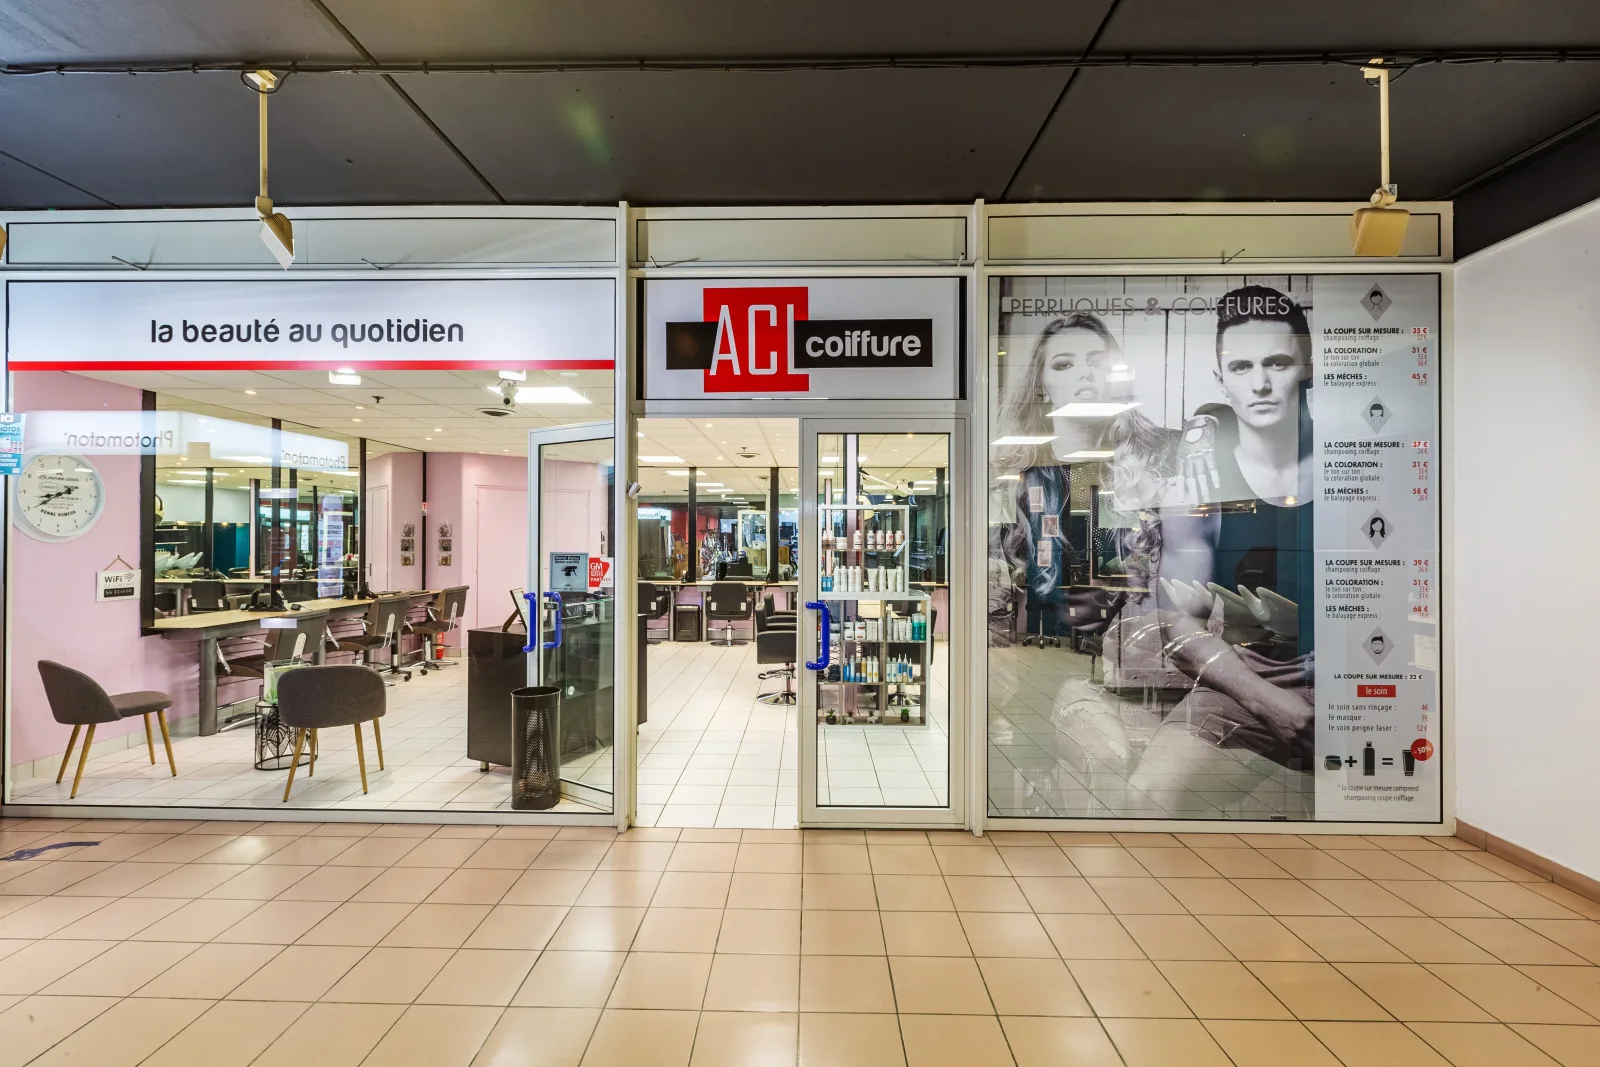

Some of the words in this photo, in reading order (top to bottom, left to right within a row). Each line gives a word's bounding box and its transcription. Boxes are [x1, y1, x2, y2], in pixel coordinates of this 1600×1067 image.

[1010, 298, 1135, 317] PERRUQUES
[1144, 297, 1164, 316] &
[1171, 296, 1290, 316] COIFFURES
[151, 320, 173, 344] la
[182, 319, 279, 344] beauté
[290, 324, 322, 342] au
[331, 318, 464, 348] quotidien
[709, 304, 809, 376] ACL
[806, 330, 922, 358] coiffure
